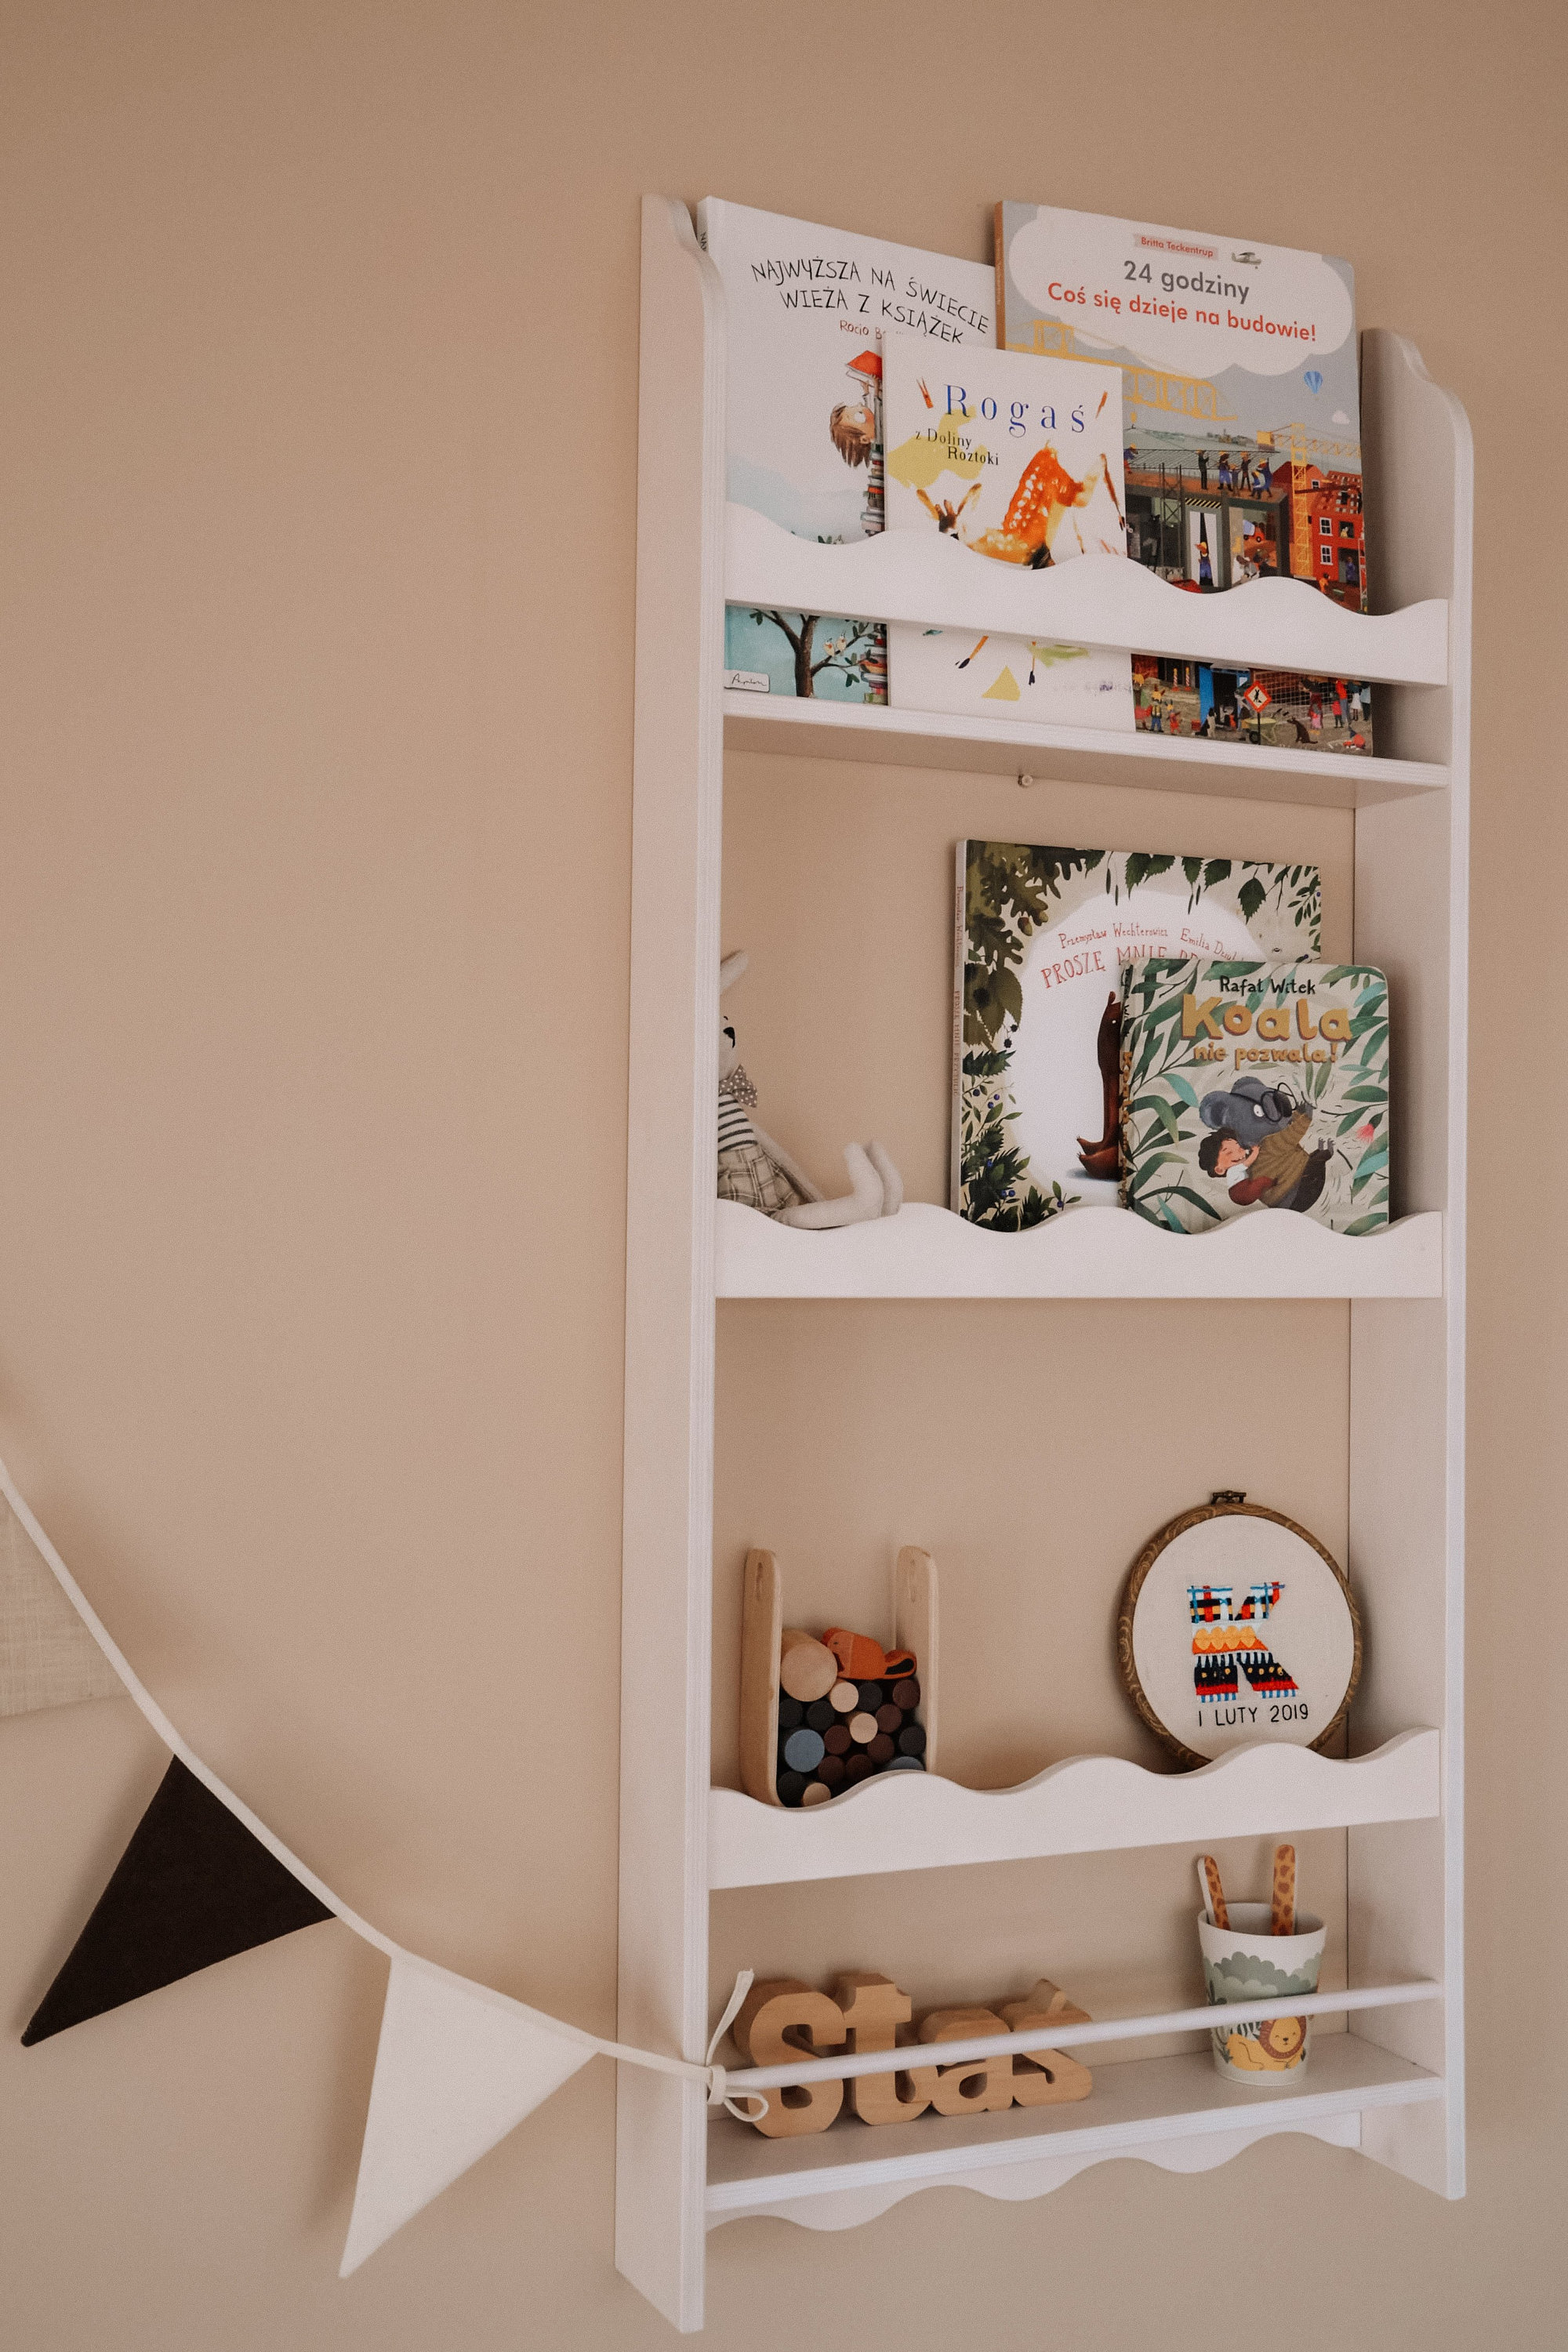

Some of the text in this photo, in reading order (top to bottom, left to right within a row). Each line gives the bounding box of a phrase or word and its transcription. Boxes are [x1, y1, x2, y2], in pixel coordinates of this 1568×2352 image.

[1141, 237, 1214, 258] Britta Teckentrup
[751, 256, 862, 286] NAJWYŻSZA
[871, 267, 895, 291] NA
[906, 277, 989, 334] ŚWIECIE
[1123, 260, 1250, 304] 24 godziny
[779, 285, 848, 310] WIEŻA
[858, 293, 870, 313] Z
[882, 299, 964, 343] KSIĄŻEK
[1047, 281, 1317, 342] Coś się dzieje na budowie!
[944, 383, 1085, 437] Rogaś
[916, 428, 972, 449] z Doliny
[948, 446, 1000, 466] Roztoki
[1112, 922, 1168, 937] Wechterowicz
[1180, 928, 1210, 950] Emilia
[1116, 944, 1167, 966] MNIE
[1219, 975, 1316, 996] Rafał Witek
[1181, 993, 1353, 1042] Koala
[1193, 1041, 1339, 1071] nie pozwala!
[1214, 1706, 1258, 1726] LUTY
[1269, 1703, 1308, 1723] 2019
[734, 1973, 1094, 2140] Staś
